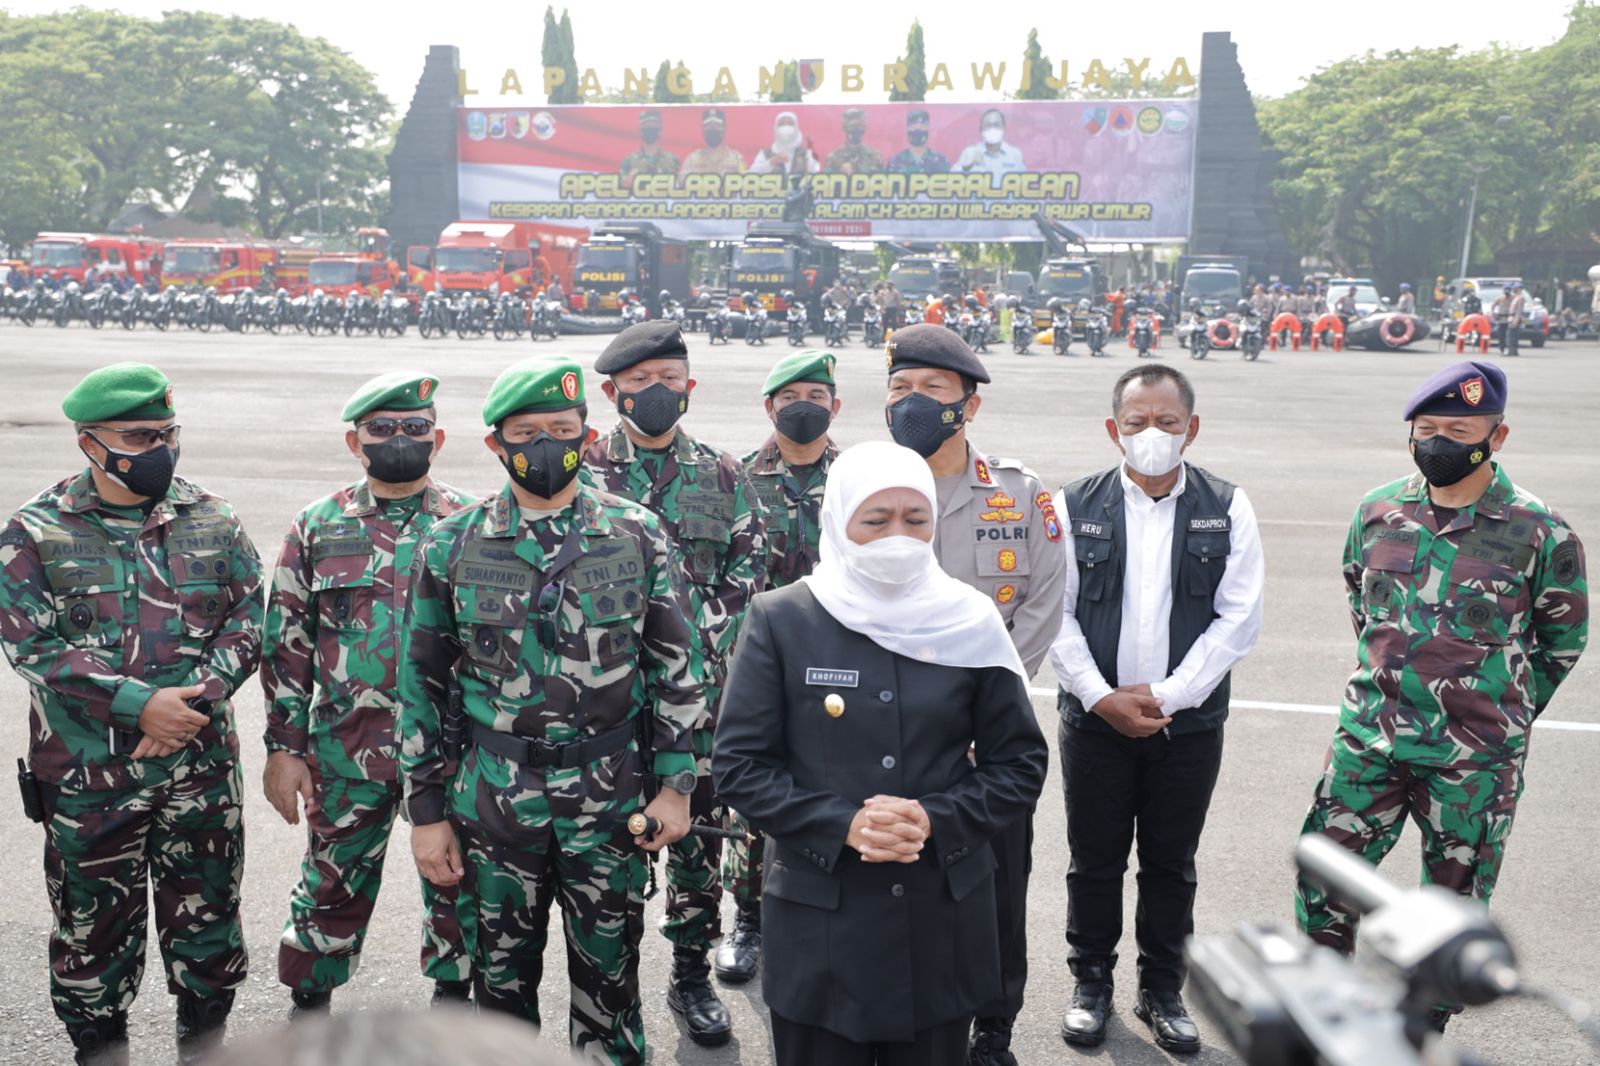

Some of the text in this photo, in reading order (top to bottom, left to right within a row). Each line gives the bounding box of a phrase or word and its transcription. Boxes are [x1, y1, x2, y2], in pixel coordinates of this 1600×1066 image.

[458, 57, 1195, 97] LAPANGAN BRAWIJAYA
[561, 174, 628, 199] APEL
[633, 174, 721, 199] GELAR
[851, 174, 906, 199] DAN
[909, 173, 1079, 199] PERALATAN
[490, 203, 570, 219] KESIAPAN
[573, 203, 730, 219] PENANGGULANGAN
[816, 203, 865, 219] ALAM
[895, 203, 938, 219] 2021
[940, 203, 957, 218] DI
[1092, 203, 1151, 219] TIMUR
[581, 272, 625, 282] POLISI
[736, 273, 785, 282] POLISI
[1080, 523, 1102, 535] HERU
[1190, 518, 1227, 529] SEKDAPROV
[976, 527, 1029, 541] POLRI
[52, 542, 107, 556] AGUS.S
[175, 535, 232, 550] TNI AD
[464, 567, 526, 586] SUHARYANTO
[582, 561, 638, 584] TNI AD
[812, 672, 854, 682] KHOFIFAH
